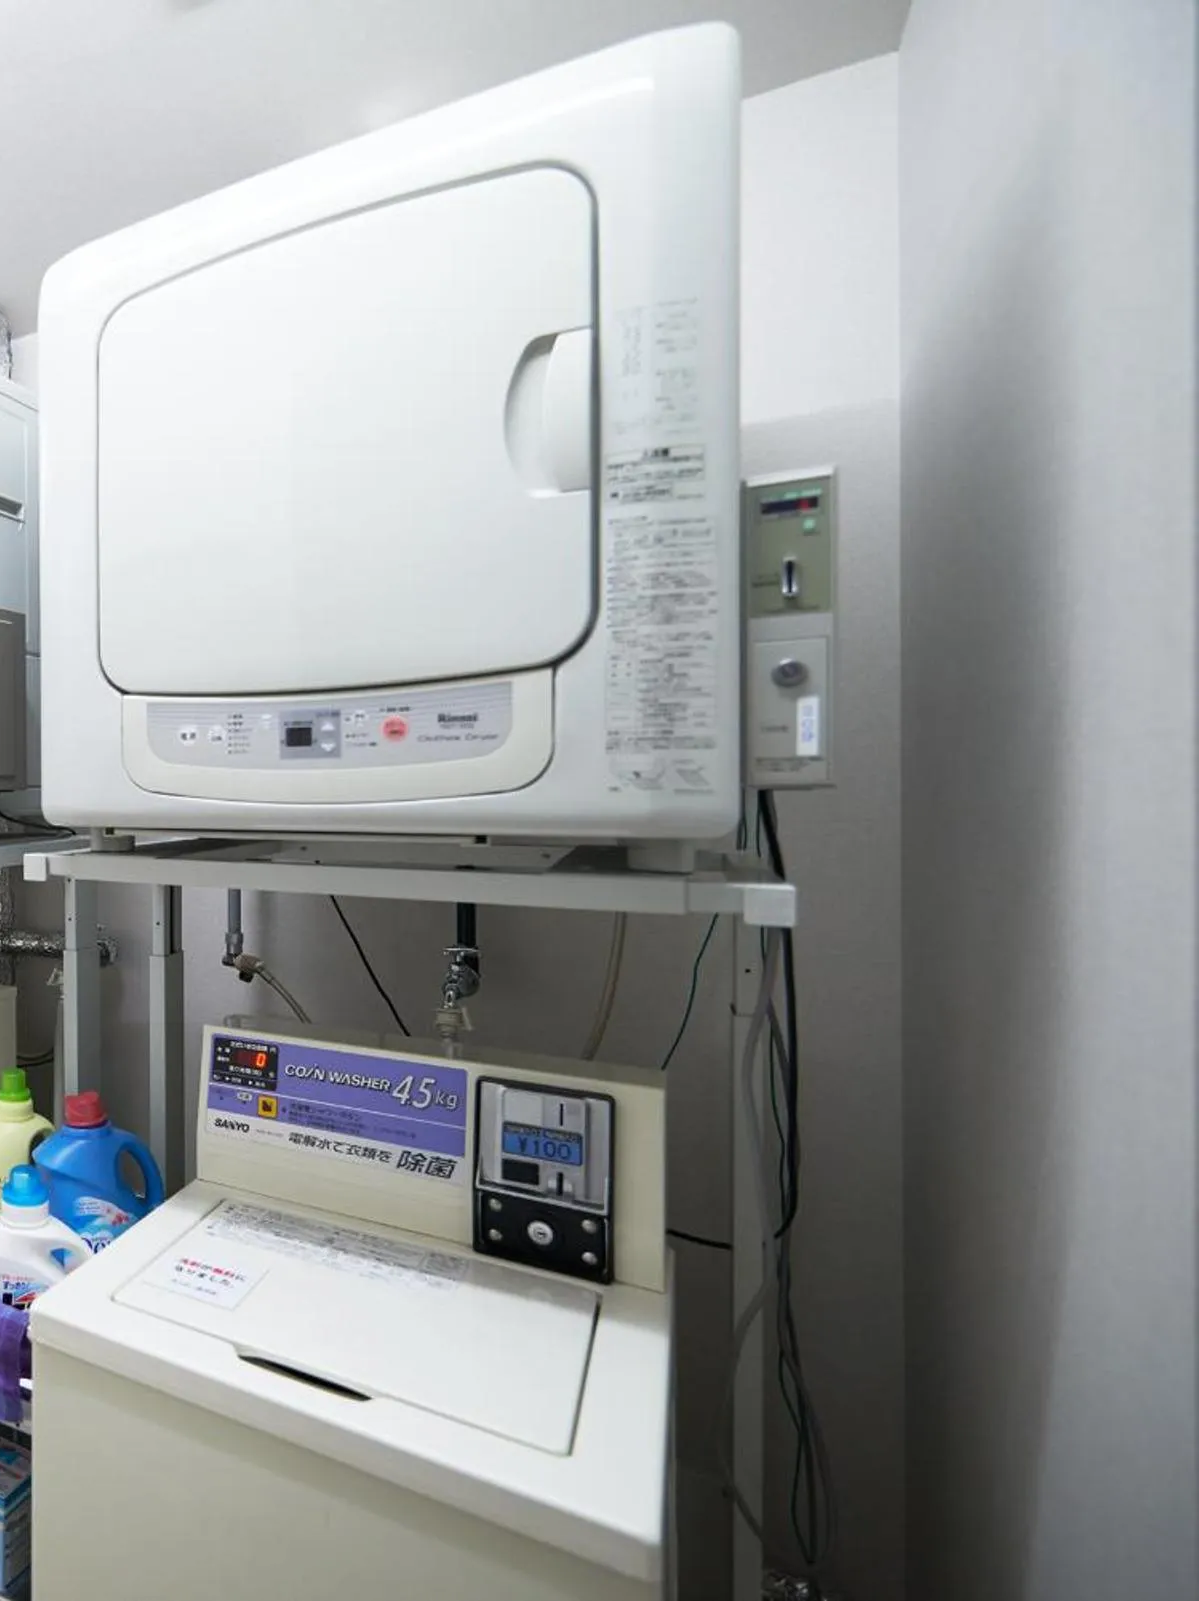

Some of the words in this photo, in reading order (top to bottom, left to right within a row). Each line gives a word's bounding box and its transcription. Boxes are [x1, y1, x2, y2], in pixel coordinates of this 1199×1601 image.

[255, 1052, 267, 1067] 0
[329, 1071, 391, 1091] WASHER
[214, 1117, 250, 1133] SANYO
[518, 1136, 572, 1160] ¥100
[396, 1149, 458, 1180] 除菌
